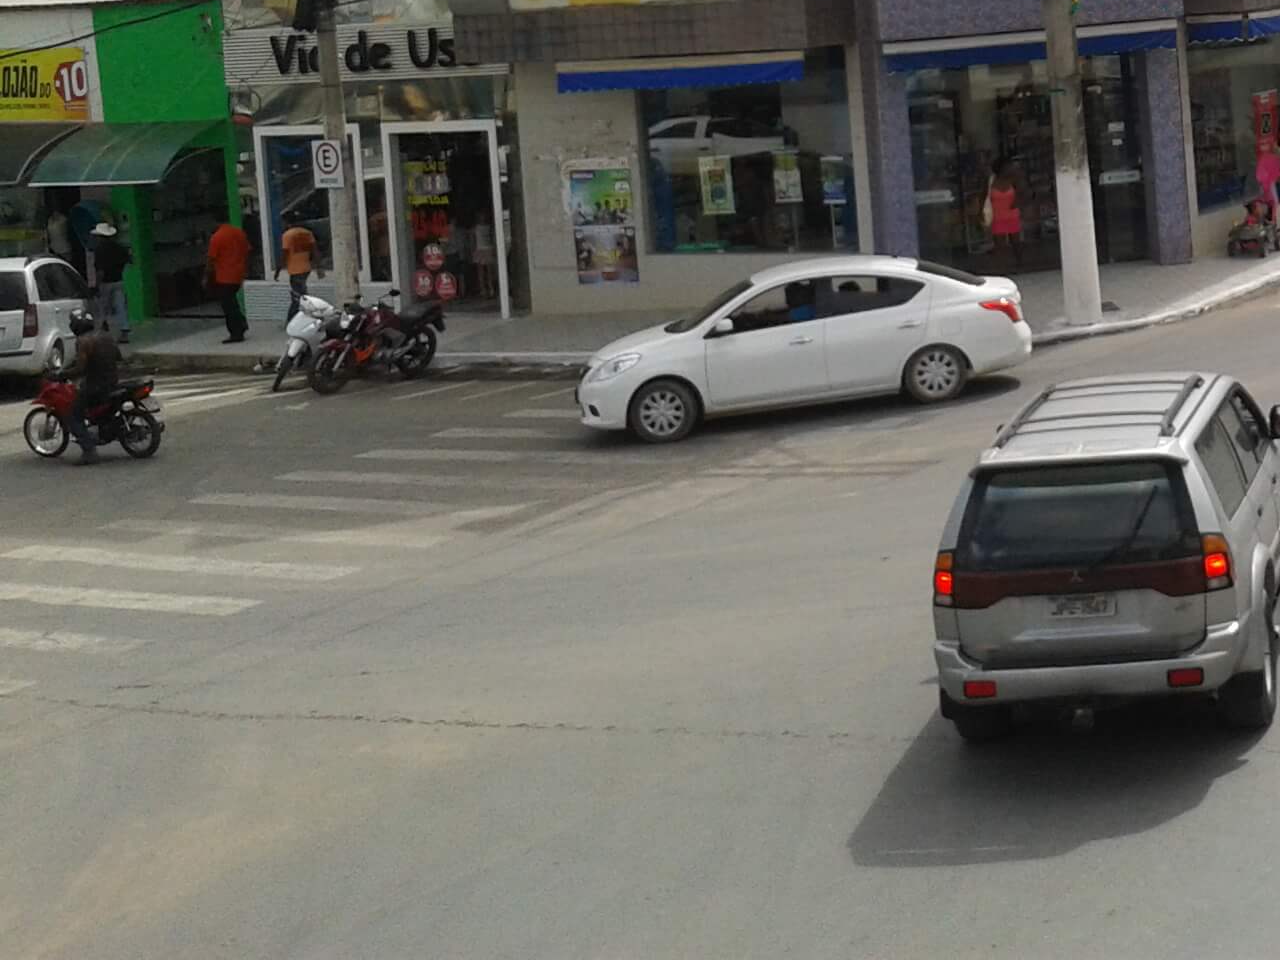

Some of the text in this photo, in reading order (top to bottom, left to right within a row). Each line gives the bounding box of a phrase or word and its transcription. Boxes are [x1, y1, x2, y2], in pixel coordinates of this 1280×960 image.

[345, 30, 392, 72] de
[407, 28, 478, 68] Us
[0, 60, 38, 98] OJÃO
[40, 82, 51, 98] DO
[322, 149, 332, 168] E
